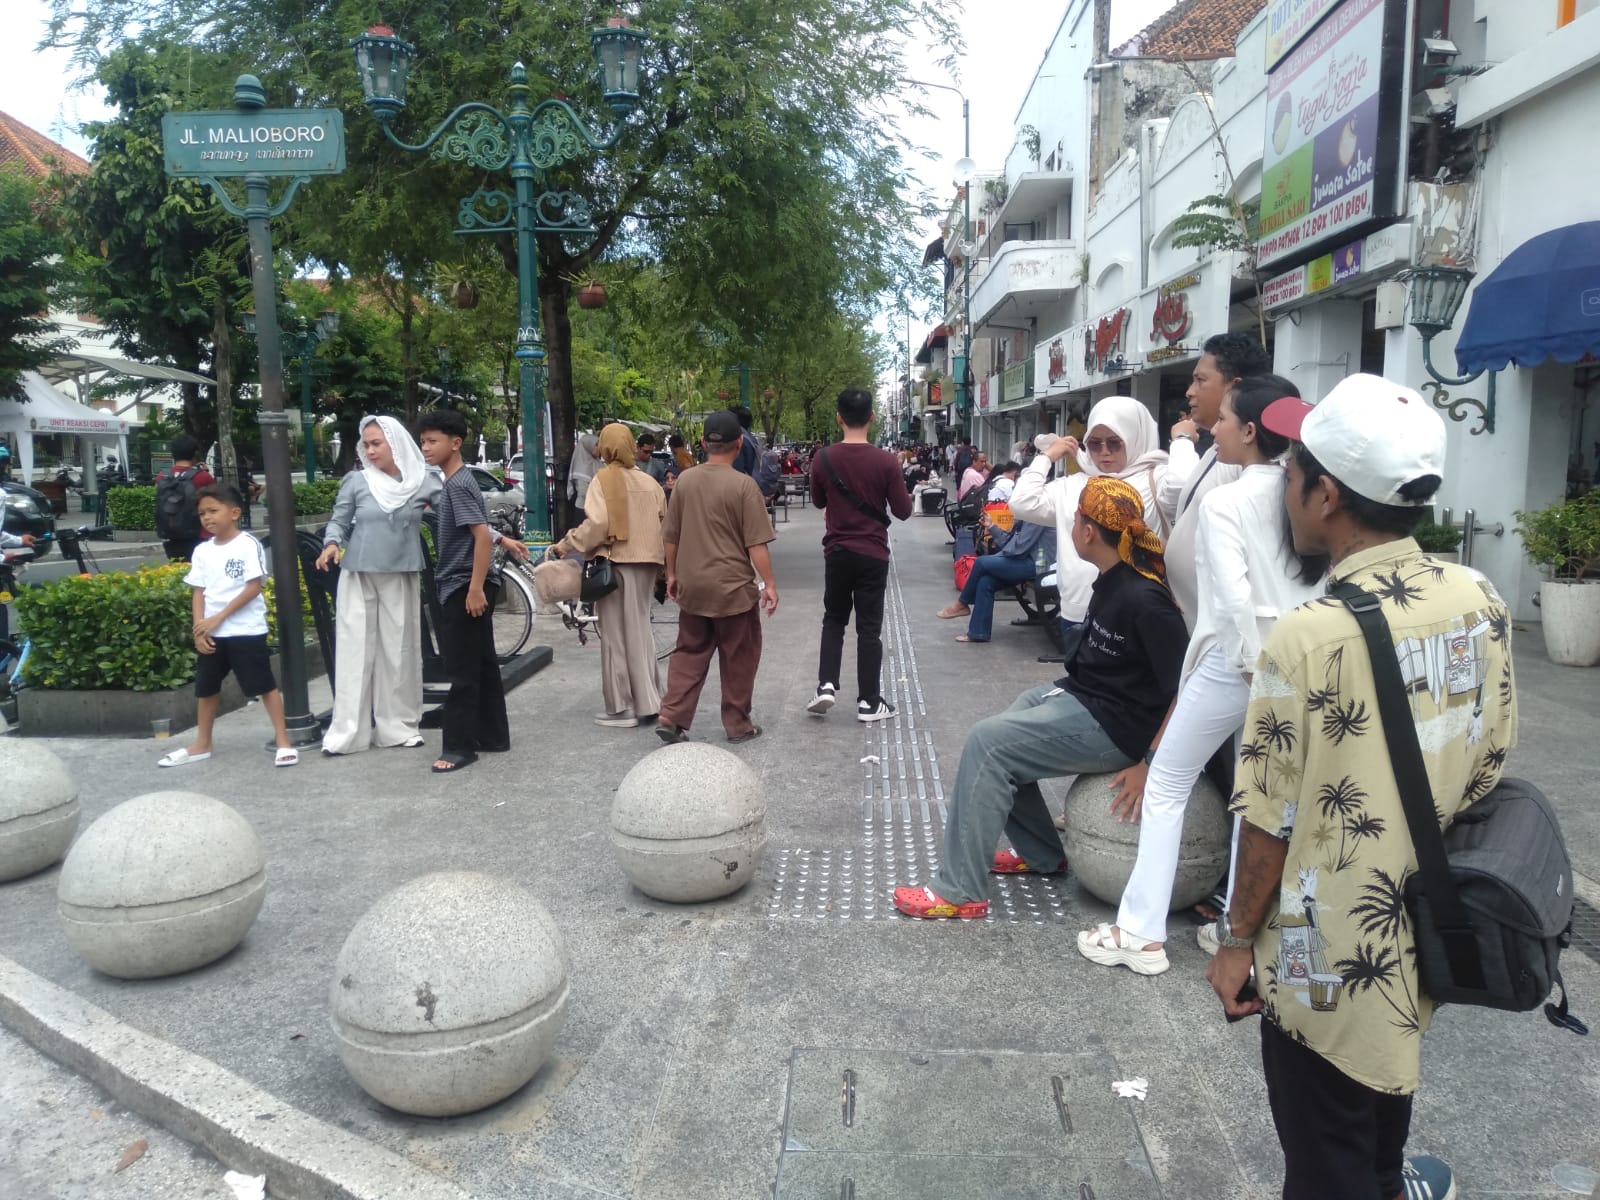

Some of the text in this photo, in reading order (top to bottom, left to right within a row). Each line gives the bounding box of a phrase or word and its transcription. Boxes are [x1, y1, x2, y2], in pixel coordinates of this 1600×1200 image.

[1297, 56, 1368, 136] tugu jogja
[180, 126, 325, 146] JL. MALIOBORO
[1312, 173, 1344, 209] juwara
[1302, 219, 1311, 240] 12
[1311, 213, 1328, 236] BOX
[1329, 202, 1344, 227] 100
[1345, 189, 1368, 220] RIBU
